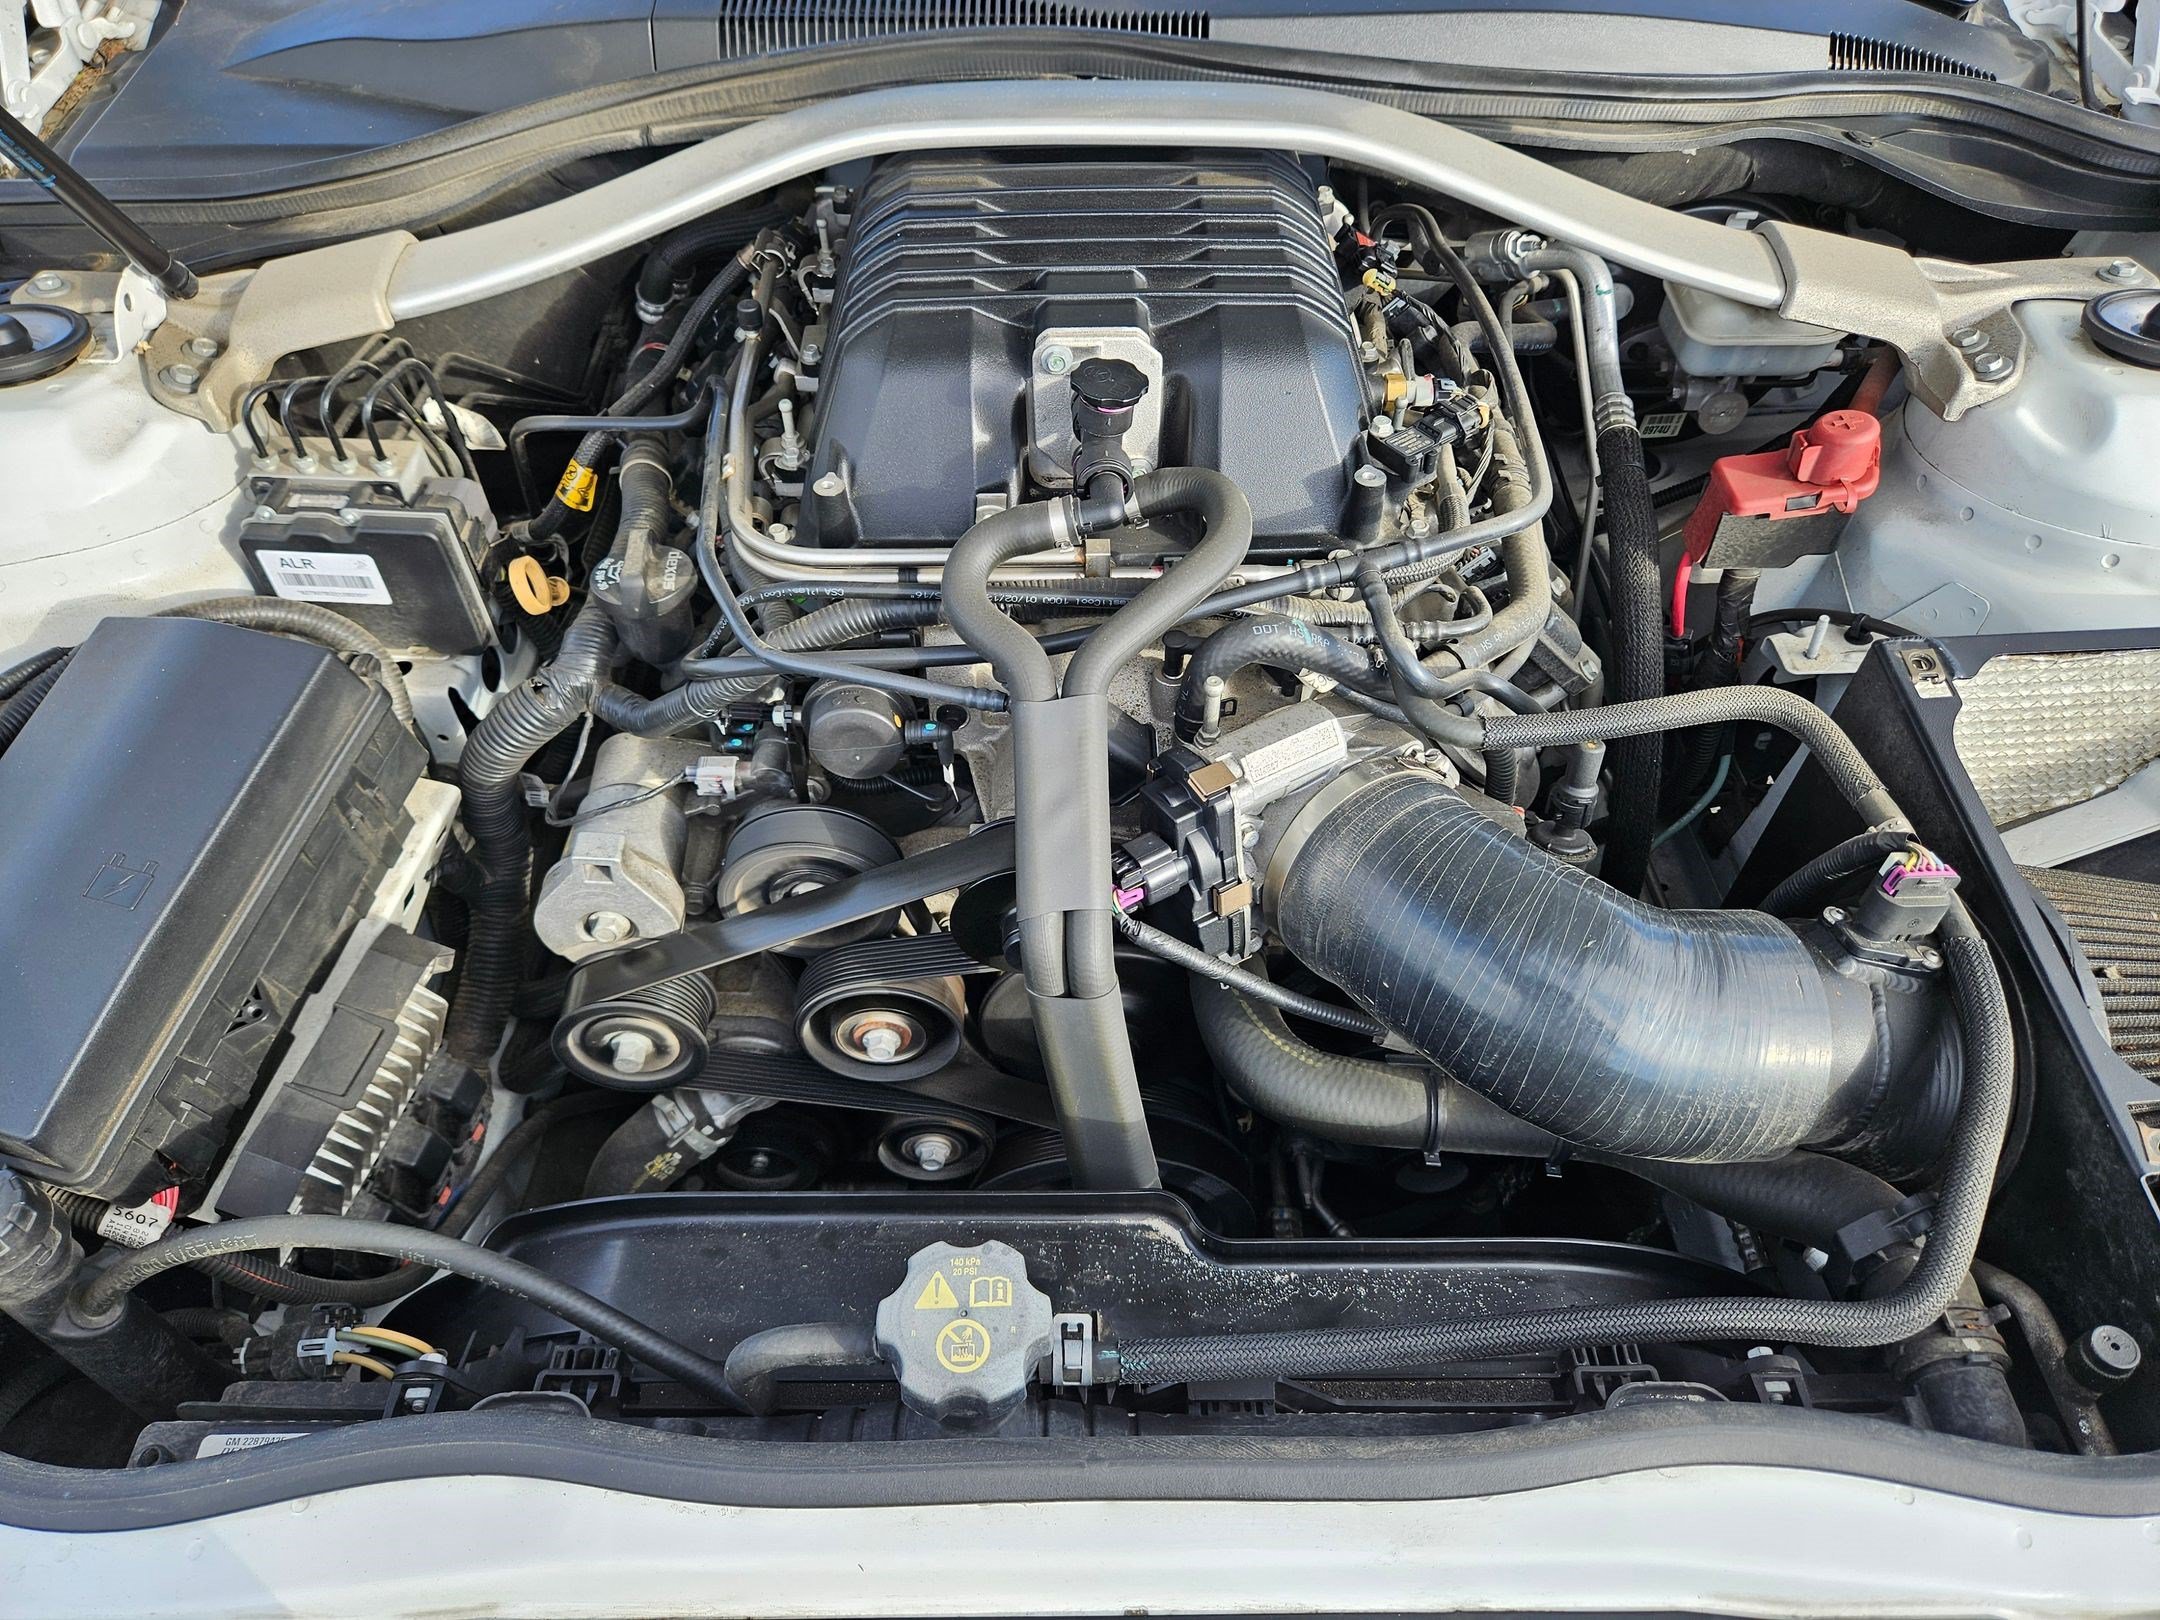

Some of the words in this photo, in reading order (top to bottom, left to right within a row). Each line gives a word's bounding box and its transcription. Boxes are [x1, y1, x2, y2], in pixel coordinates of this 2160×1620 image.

[280, 557, 316, 569] ALR
[663, 551, 682, 591] dexos
[1252, 623, 1280, 636] DOT
[113, 1206, 158, 1228] 5607
[950, 1257, 964, 1267] 140
[965, 1257, 981, 1266] kPa
[952, 1267, 962, 1276] 20
[963, 1267, 977, 1276] PSI
[226, 1437, 241, 1446] GM
